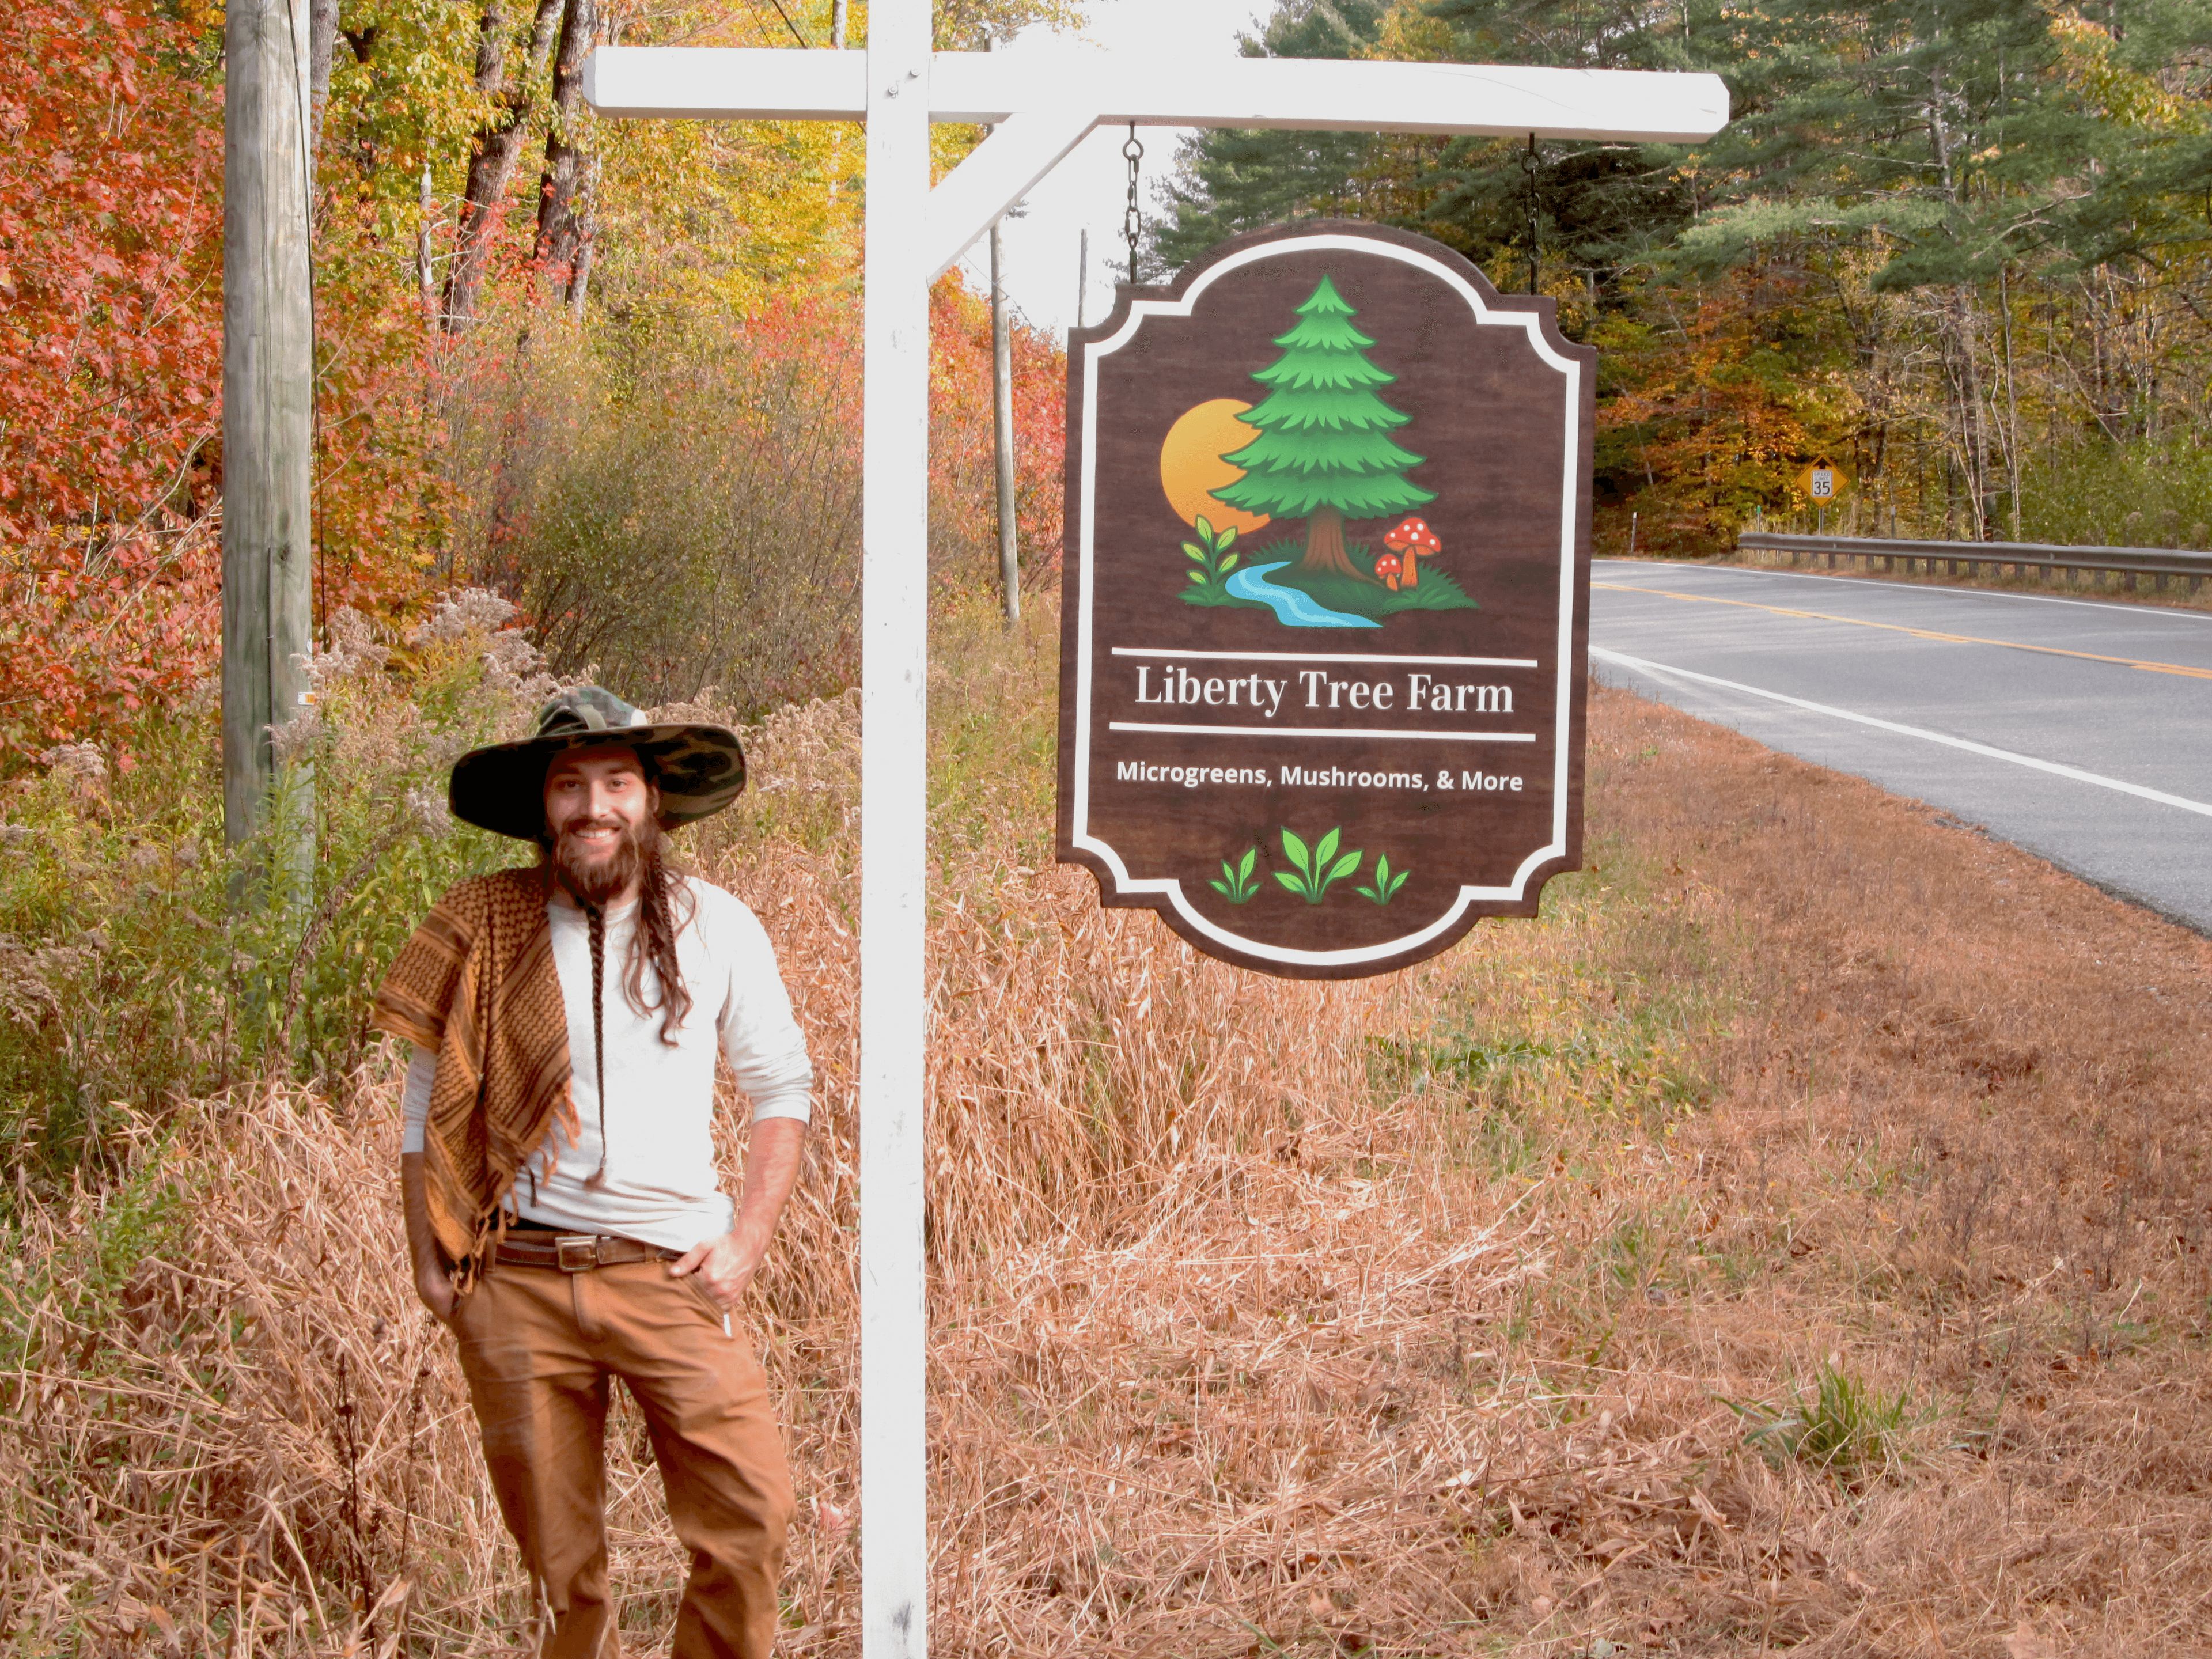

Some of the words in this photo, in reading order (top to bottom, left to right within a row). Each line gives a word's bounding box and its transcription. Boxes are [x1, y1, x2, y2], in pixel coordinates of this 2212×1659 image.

[1814, 481, 1830, 494] 35
[1135, 665, 1288, 718] Liberty
[1299, 671, 1393, 710] Tree
[1407, 673, 1514, 713] Farm
[1116, 760, 1272, 788] Microgreens,
[1281, 766, 1429, 791] Mushrooms,
[1437, 770, 1455, 790] &
[1462, 771, 1523, 791] More
